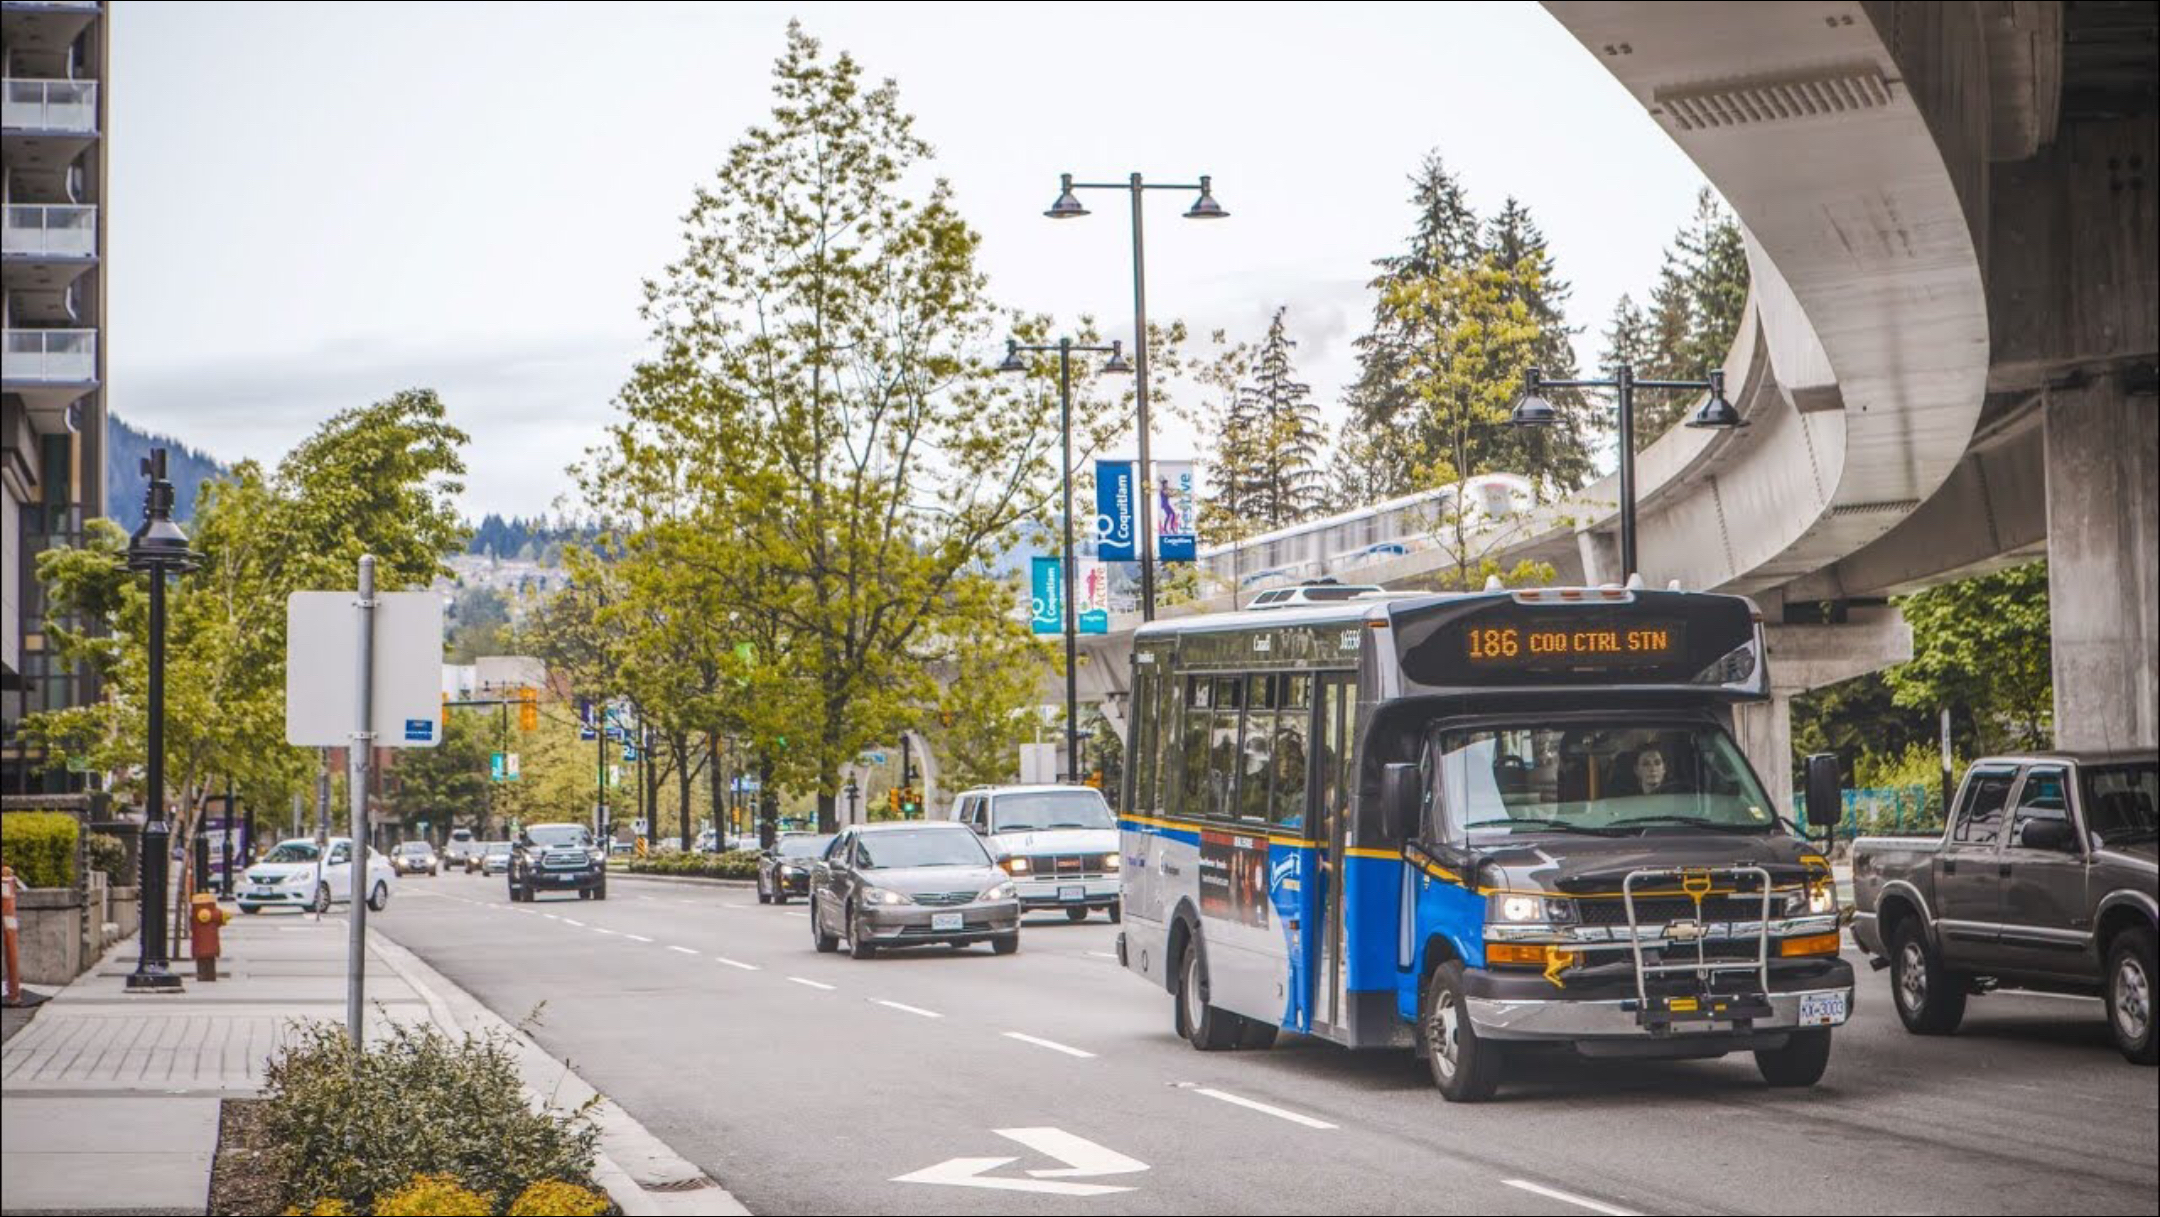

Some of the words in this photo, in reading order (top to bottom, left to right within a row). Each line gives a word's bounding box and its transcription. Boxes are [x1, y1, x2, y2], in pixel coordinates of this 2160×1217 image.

[1116, 474, 1131, 539] Coquitlam
[1469, 628, 1518, 658] 186
[1529, 632, 1567, 653] COQ
[1573, 631, 1622, 652] CTRL
[1627, 630, 1668, 651] STN
